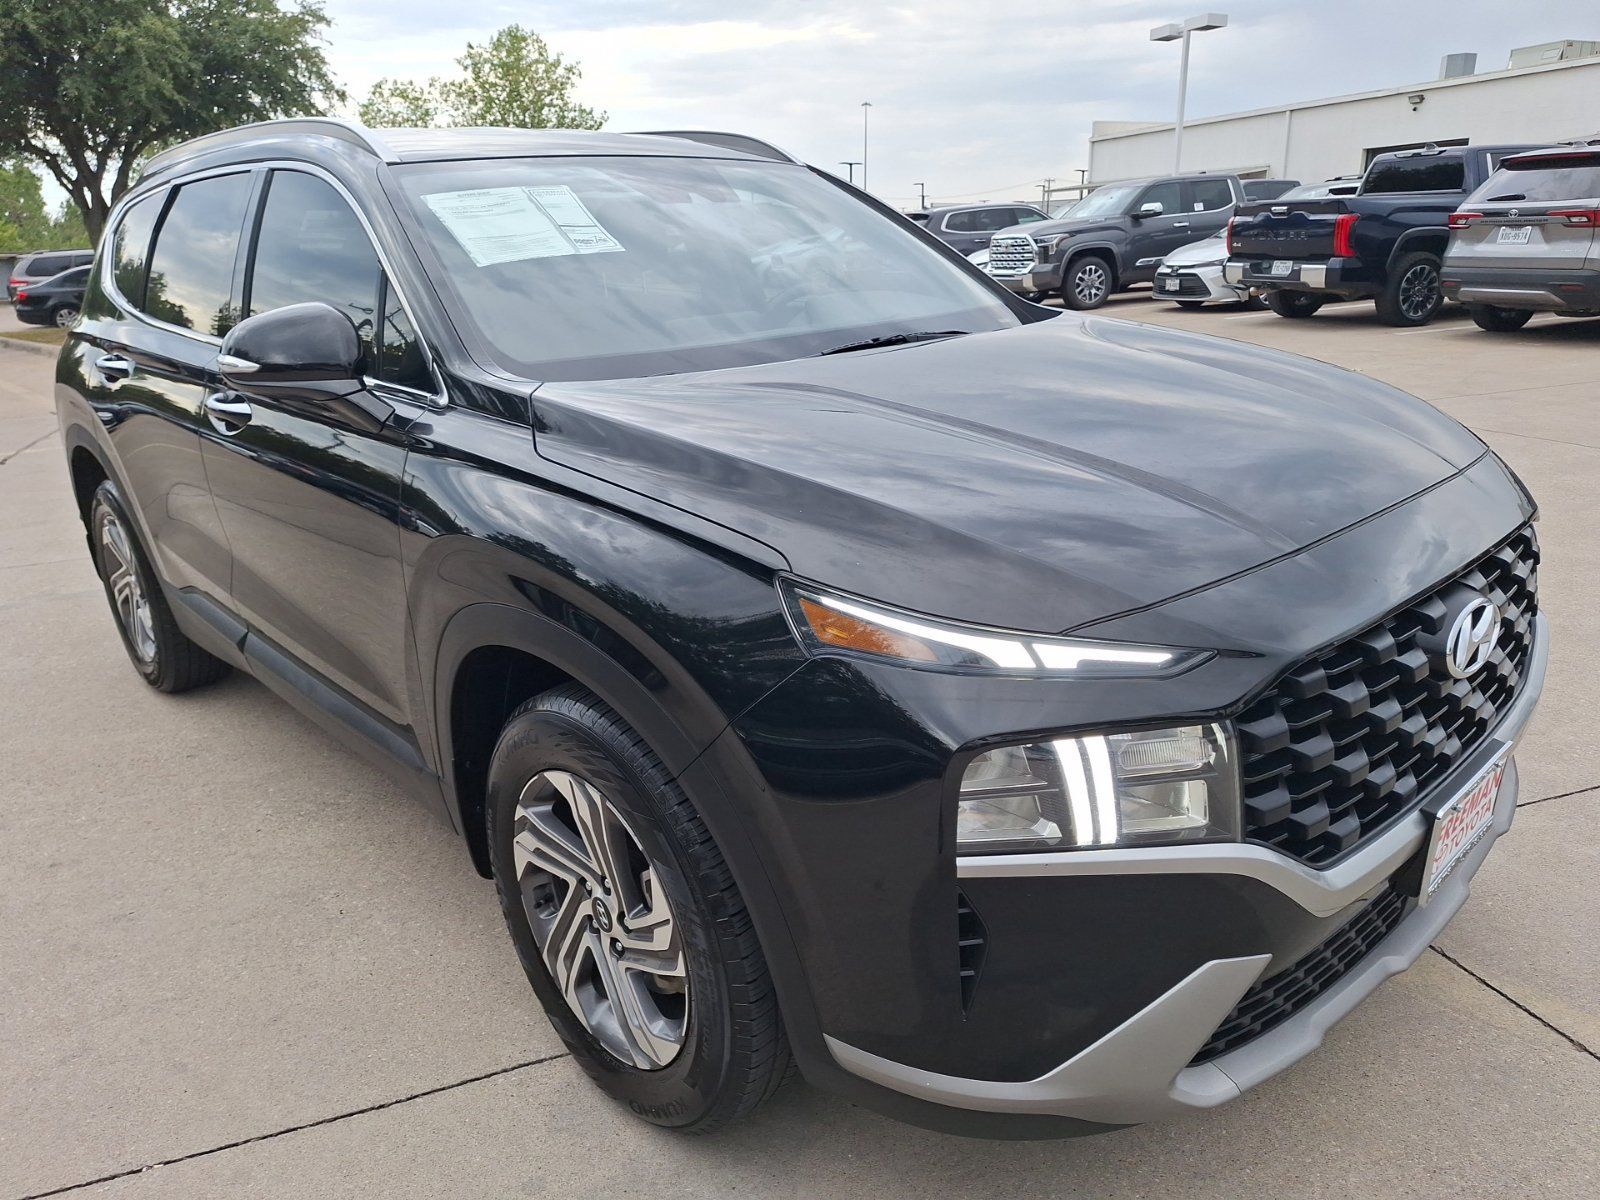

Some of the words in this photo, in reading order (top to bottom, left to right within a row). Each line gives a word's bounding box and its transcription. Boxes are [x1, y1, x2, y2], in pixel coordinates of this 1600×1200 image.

[1250, 231, 1309, 240] TUNDRA
[1440, 768, 1504, 844] FREEMAN
[1449, 798, 1492, 854] TOYOTA
